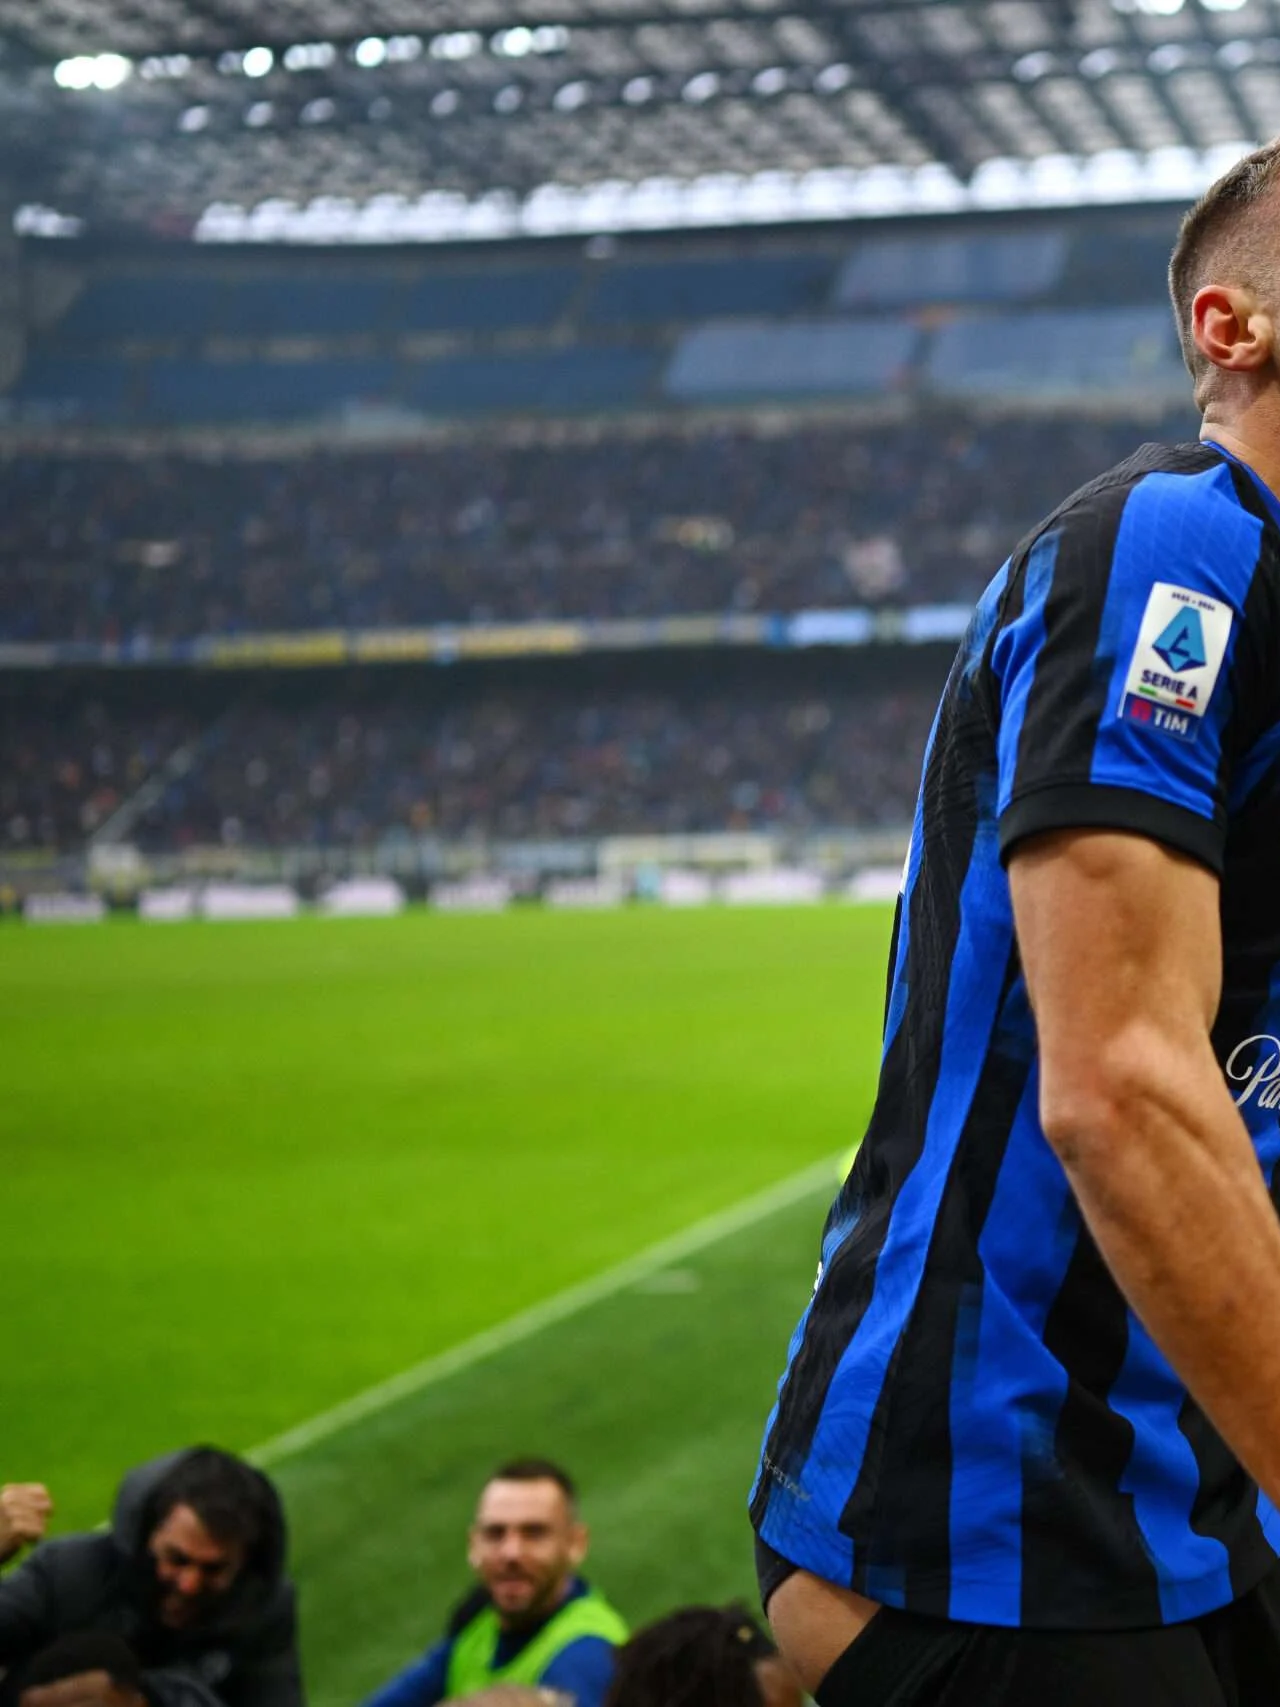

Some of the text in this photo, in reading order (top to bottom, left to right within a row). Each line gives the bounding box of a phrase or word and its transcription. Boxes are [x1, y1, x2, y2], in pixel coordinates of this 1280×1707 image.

[1141, 669, 1199, 700] SERIE A
[1153, 707, 1189, 735] TIM
